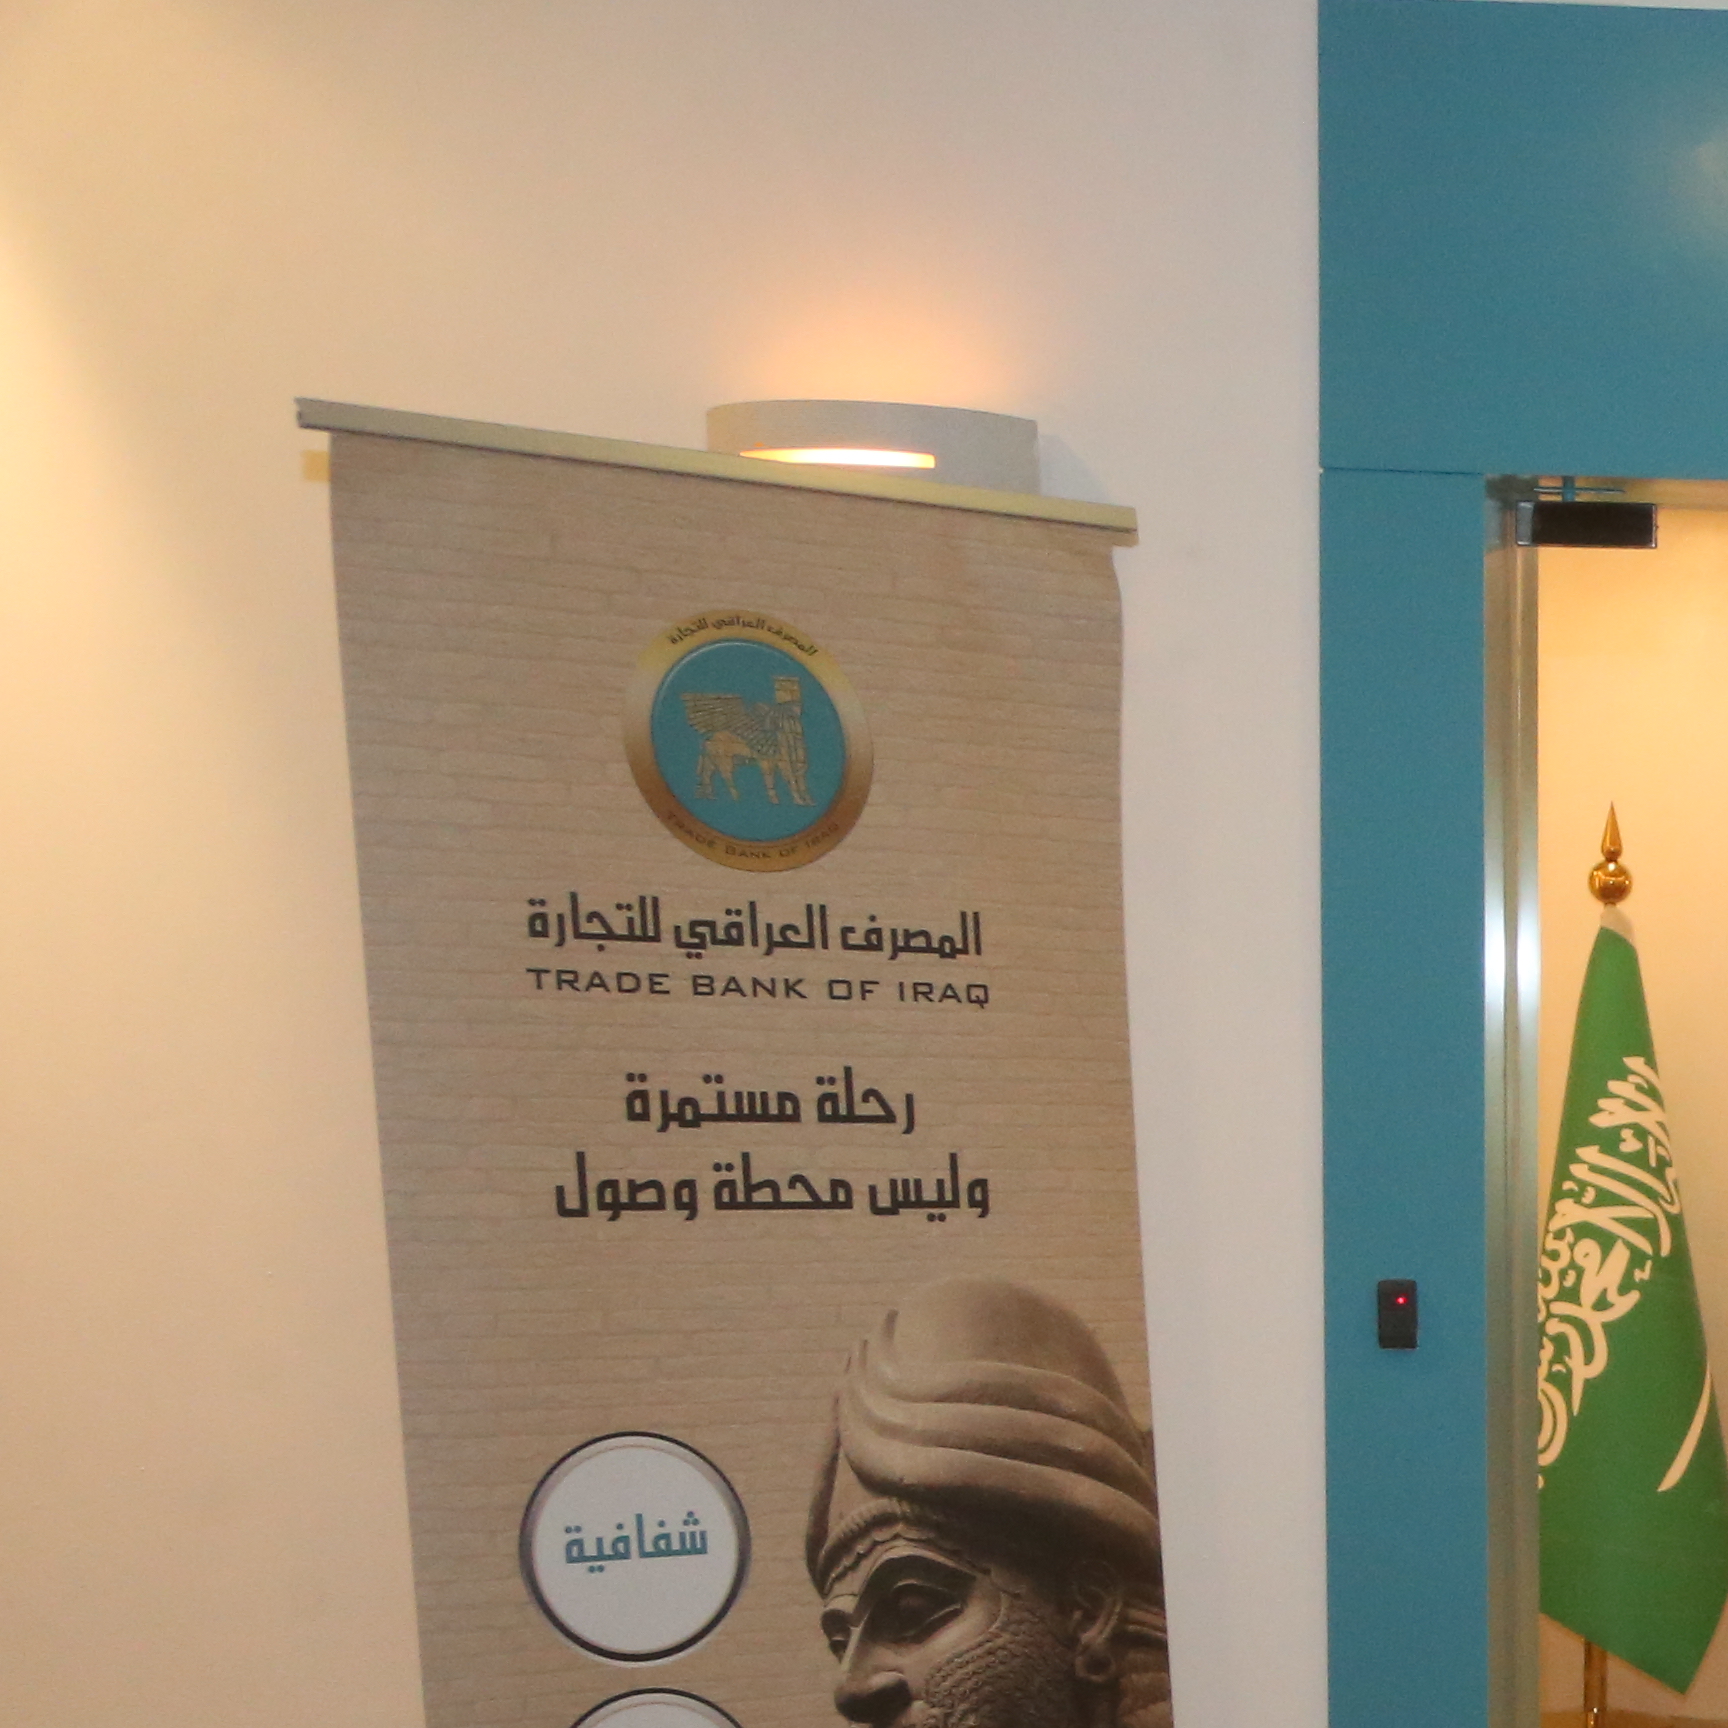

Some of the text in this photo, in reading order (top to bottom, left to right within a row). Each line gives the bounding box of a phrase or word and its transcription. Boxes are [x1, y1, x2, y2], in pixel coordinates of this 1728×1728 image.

[527, 891, 983, 960] المصرف العراقي للتجارة
[526, 968, 990, 1009] TRADE BANK OF IRAQ
[625, 1066, 915, 1135] رحلة مستمرة
[555, 1151, 990, 1223] وليس محطة وصول
[564, 1511, 708, 1573] شفافية
